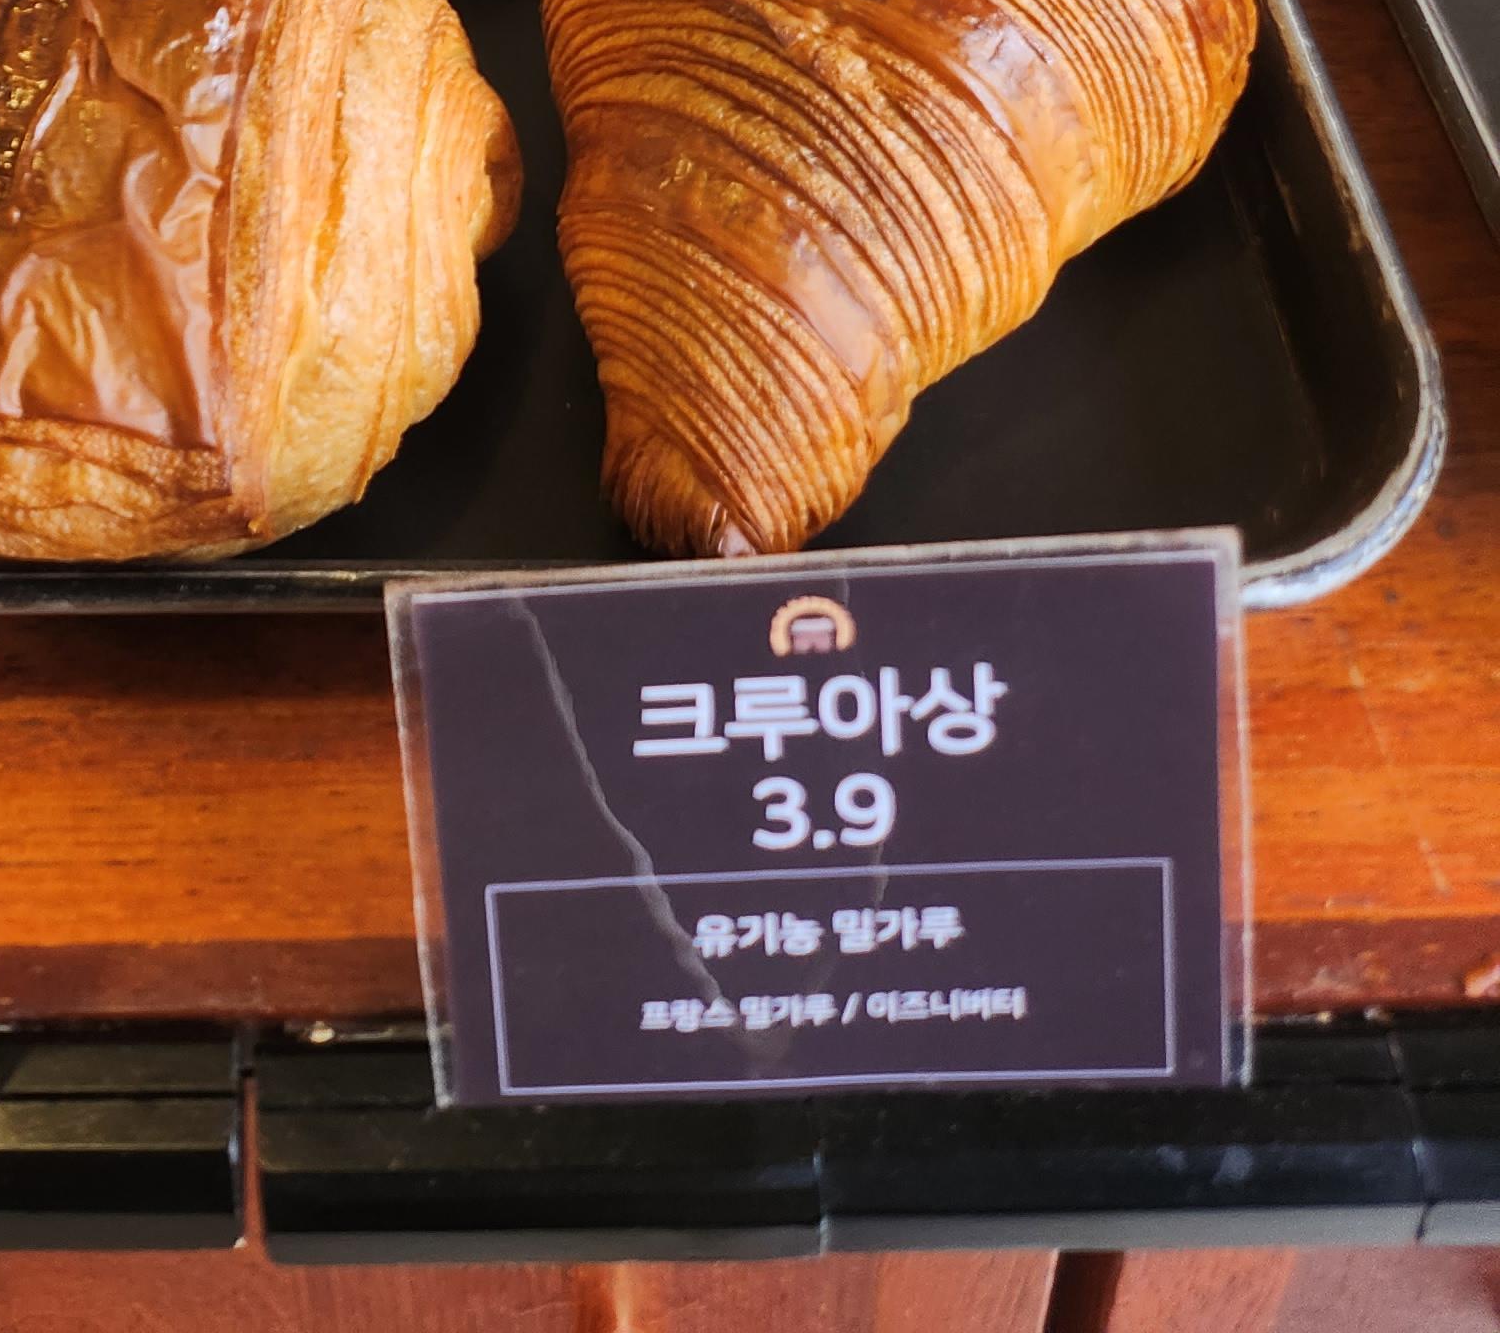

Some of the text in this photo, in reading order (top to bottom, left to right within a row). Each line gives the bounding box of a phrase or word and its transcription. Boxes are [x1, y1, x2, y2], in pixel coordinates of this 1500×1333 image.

[632, 662, 1008, 762] 크루아상
[752, 773, 896, 850] 3.9
[693, 906, 965, 958] 유기농 밀가루
[640, 986, 1027, 1033] 프랑스 밀가루 / 이즈니버터
